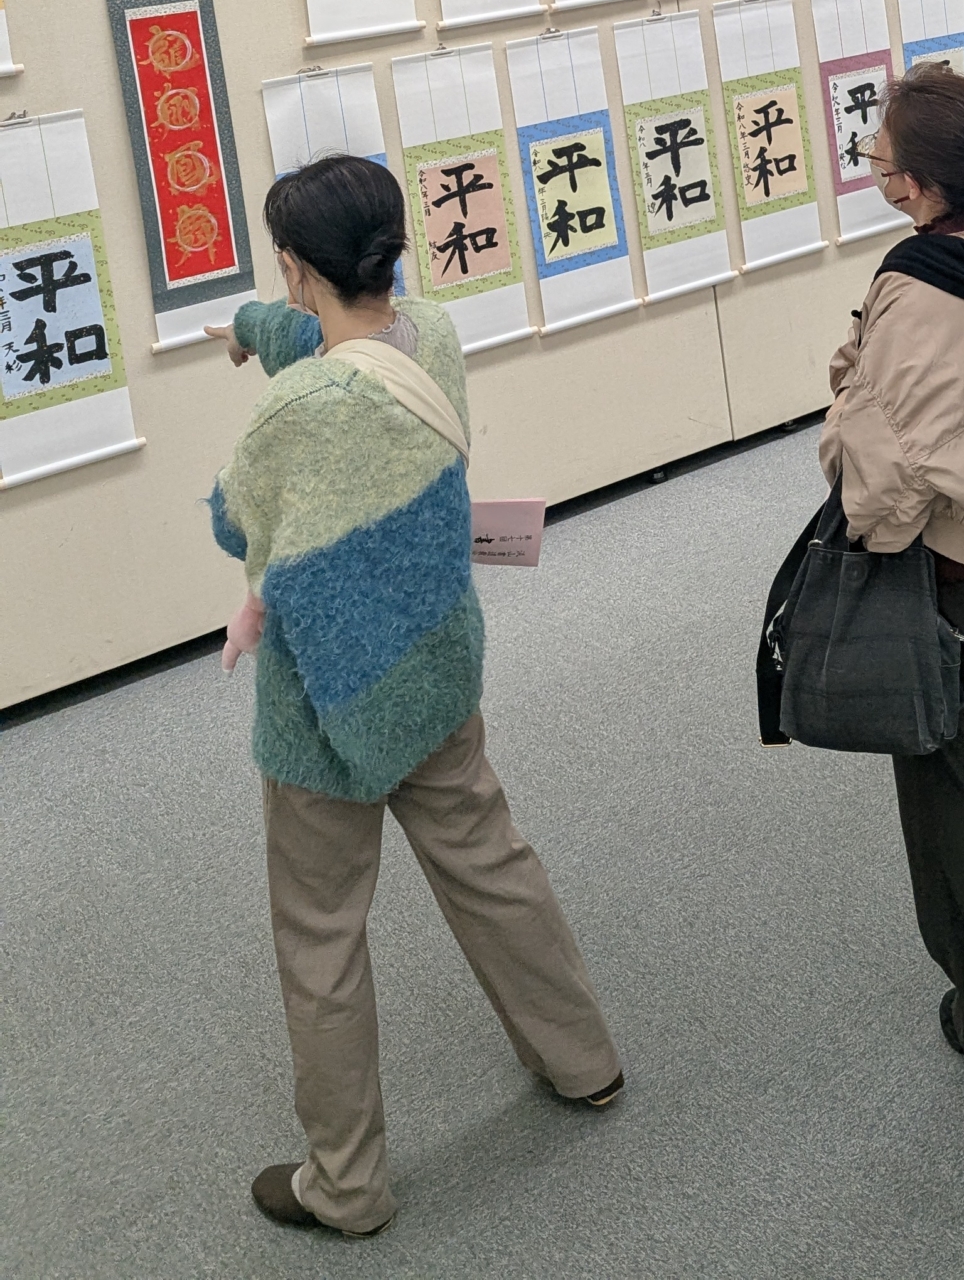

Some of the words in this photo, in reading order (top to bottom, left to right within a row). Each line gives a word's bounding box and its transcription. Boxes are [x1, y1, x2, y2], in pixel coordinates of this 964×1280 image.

[536, 142, 605, 257] 平和
[645, 118, 711, 222] 平和
[748, 100, 797, 198] 平和
[432, 163, 498, 278] 平和
[9, 250, 109, 385] 平和
